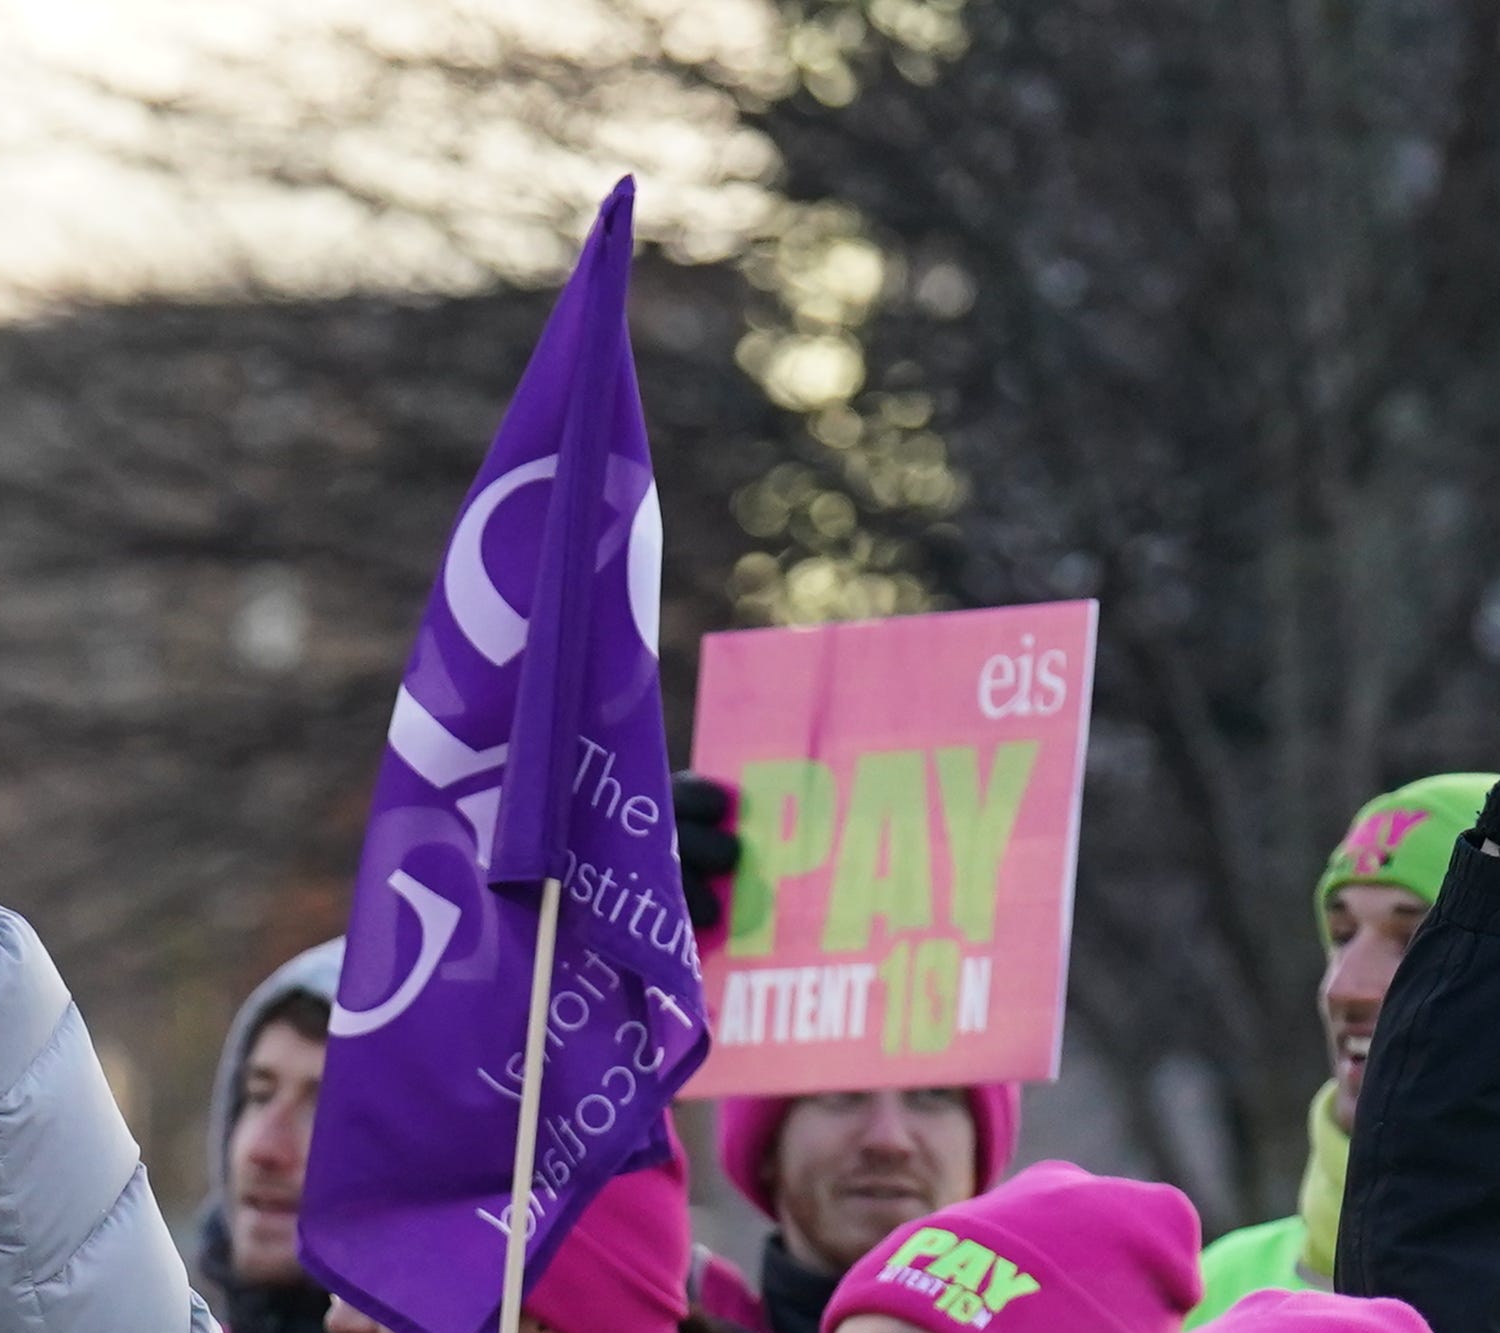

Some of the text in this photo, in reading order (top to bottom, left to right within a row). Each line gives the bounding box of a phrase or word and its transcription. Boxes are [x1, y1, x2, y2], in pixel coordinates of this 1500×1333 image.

[976, 634, 1069, 719] eis
[573, 734, 661, 838] The
[727, 740, 1041, 957] PAY
[886, 1226, 1042, 1314] PAY
